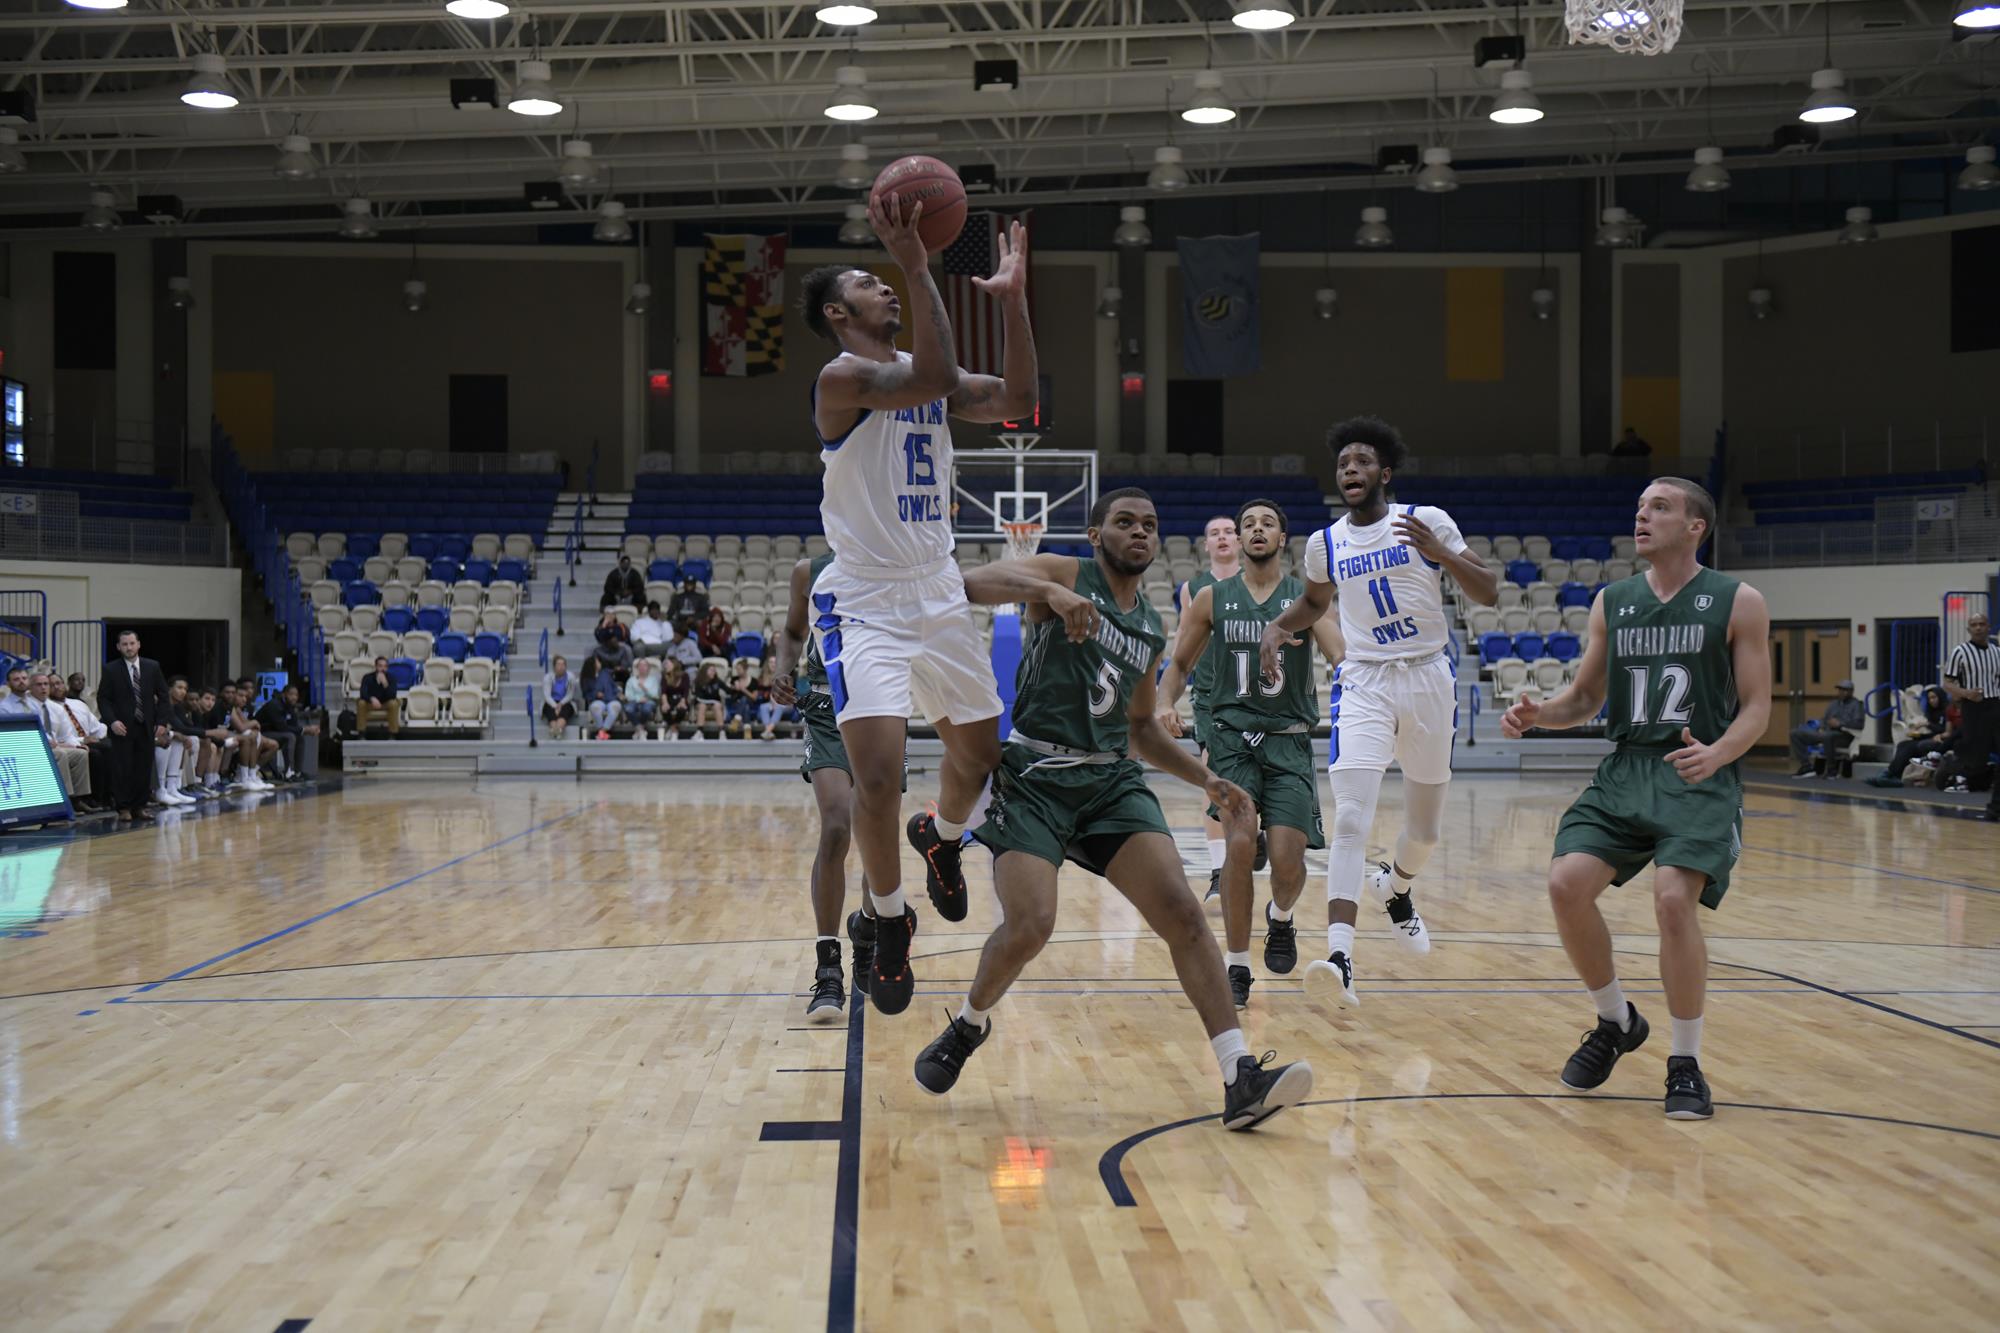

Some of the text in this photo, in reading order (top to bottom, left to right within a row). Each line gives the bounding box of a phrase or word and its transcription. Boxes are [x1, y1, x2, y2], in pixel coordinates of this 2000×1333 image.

[903, 432, 937, 486] 15
[897, 494, 943, 522] OWLS
[1337, 544, 1410, 581] FIGHTING
[1368, 576, 1399, 619] 11
[1223, 619, 1261, 643] RICHARD
[1372, 616, 1419, 645] OWLS
[1617, 624, 1704, 657] RICHARD BLAND
[1088, 658, 1122, 718] 5
[1229, 650, 1286, 697] 15
[1624, 663, 1696, 726] 12
